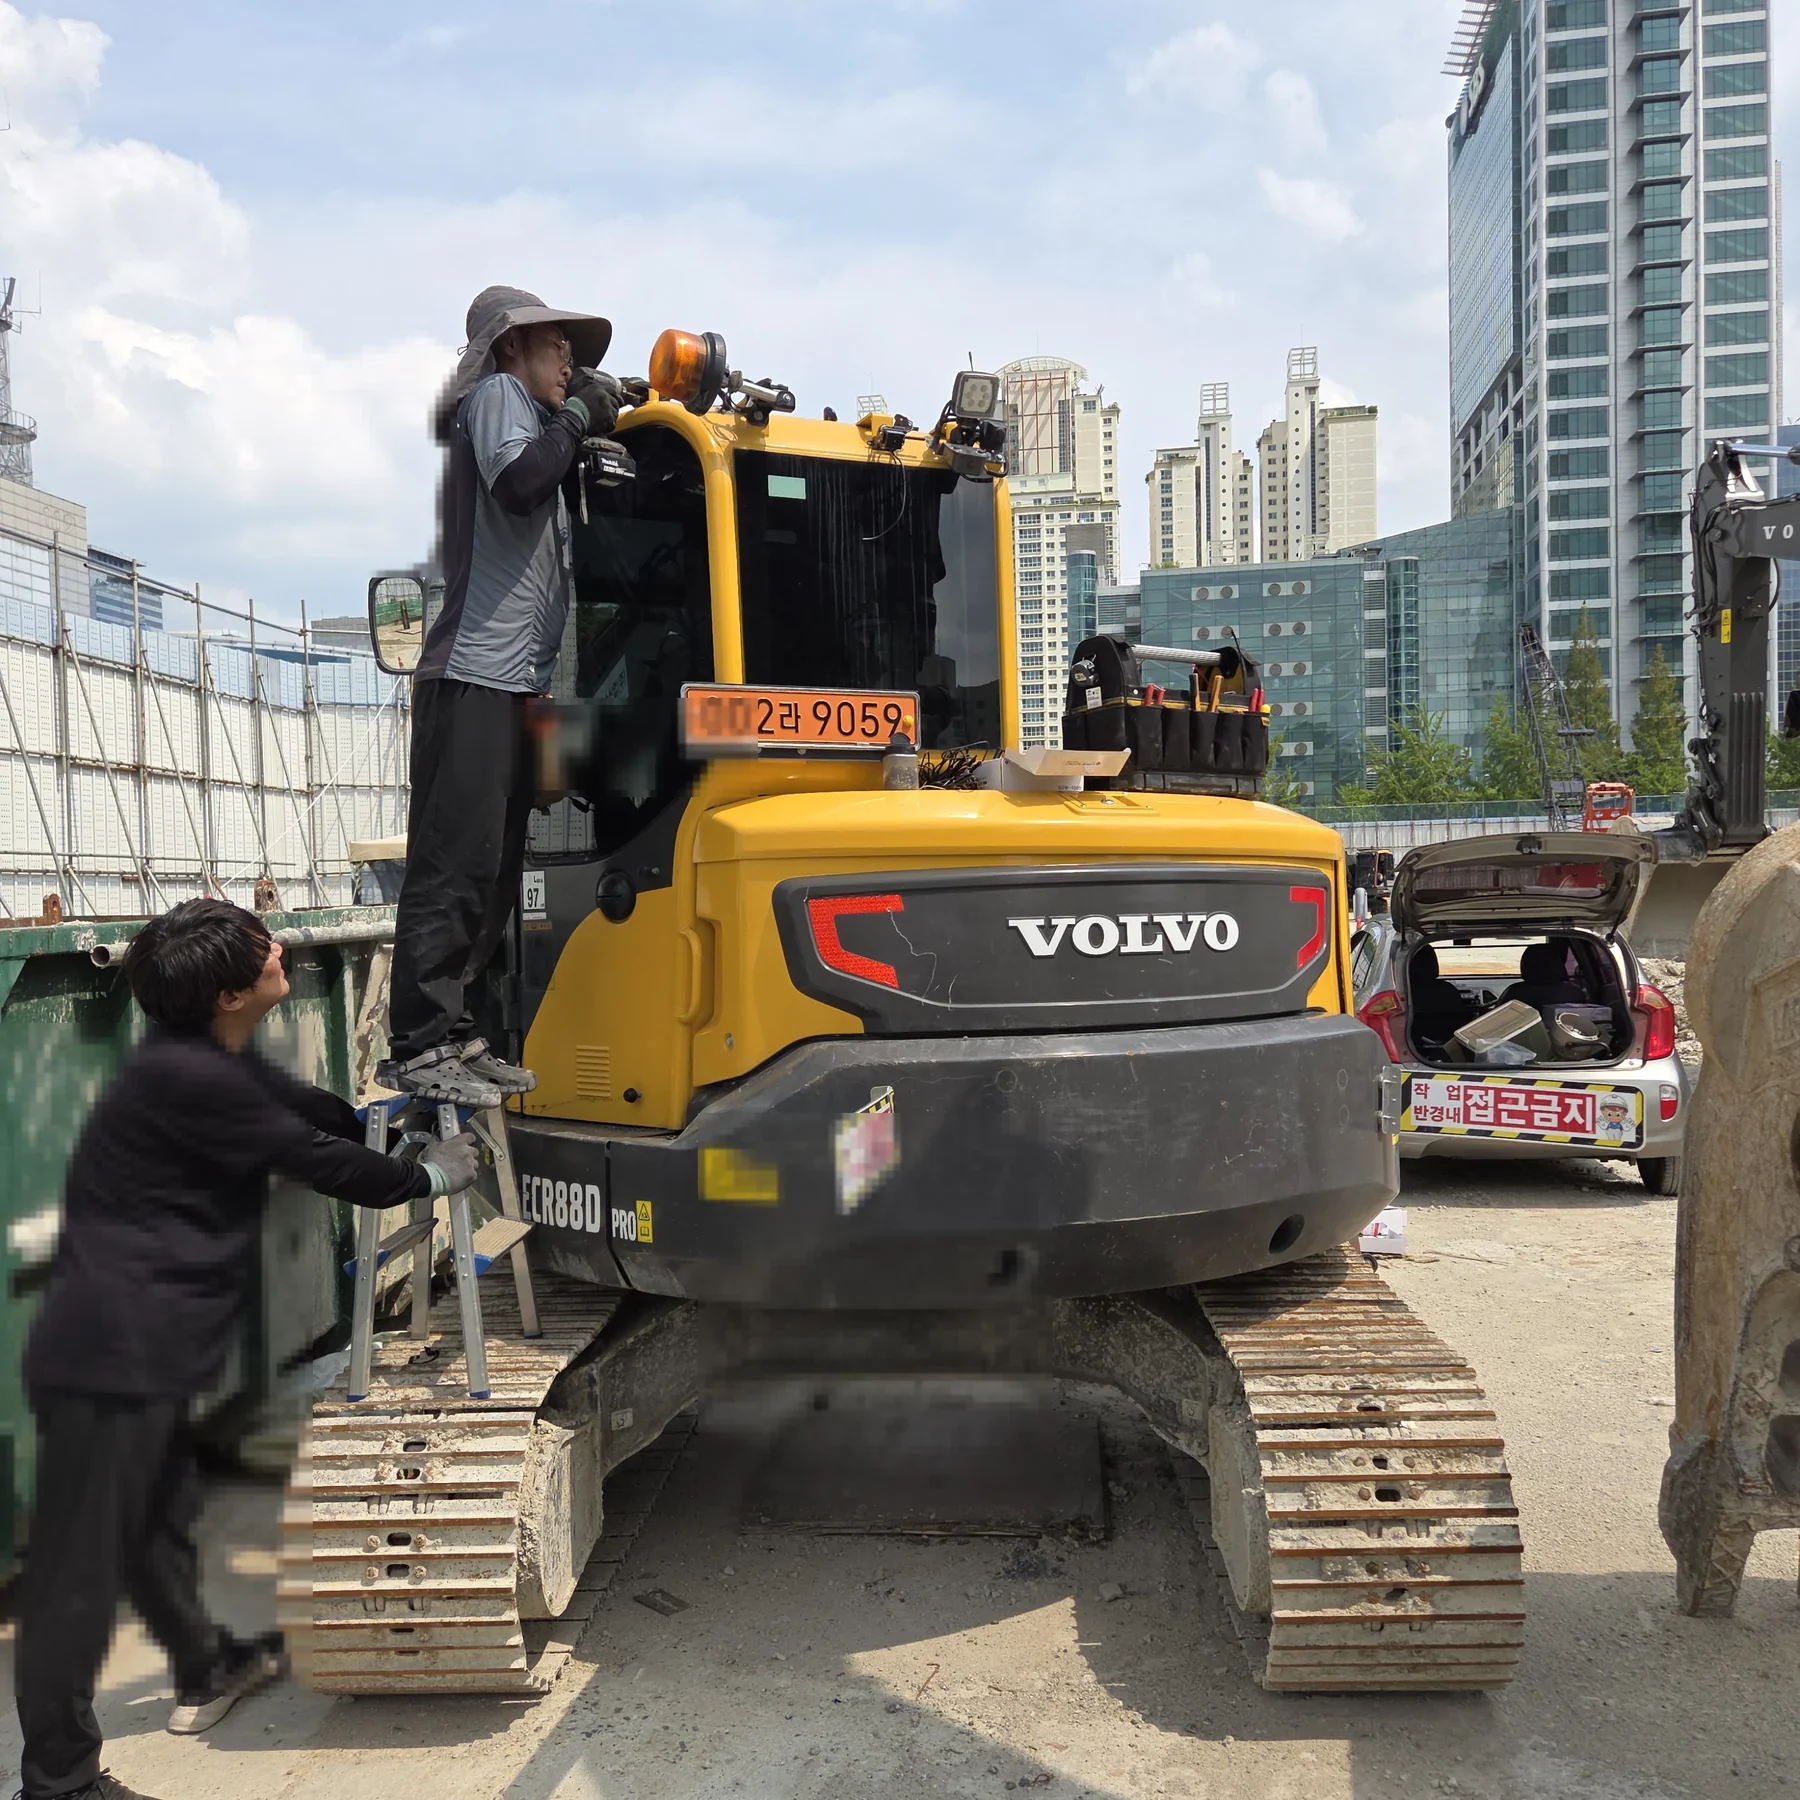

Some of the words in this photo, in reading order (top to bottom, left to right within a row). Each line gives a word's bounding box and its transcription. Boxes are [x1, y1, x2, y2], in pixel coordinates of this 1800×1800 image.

[812, 700, 902, 738] 9059
[527, 887, 540, 908] 97
[1008, 912, 1239, 956] VOLVO
[1413, 1105, 1461, 1124] 반경내
[1465, 1088, 1594, 1132] 접근금지
[522, 1174, 600, 1233] ECR88D
[611, 1208, 637, 1241] PRO
